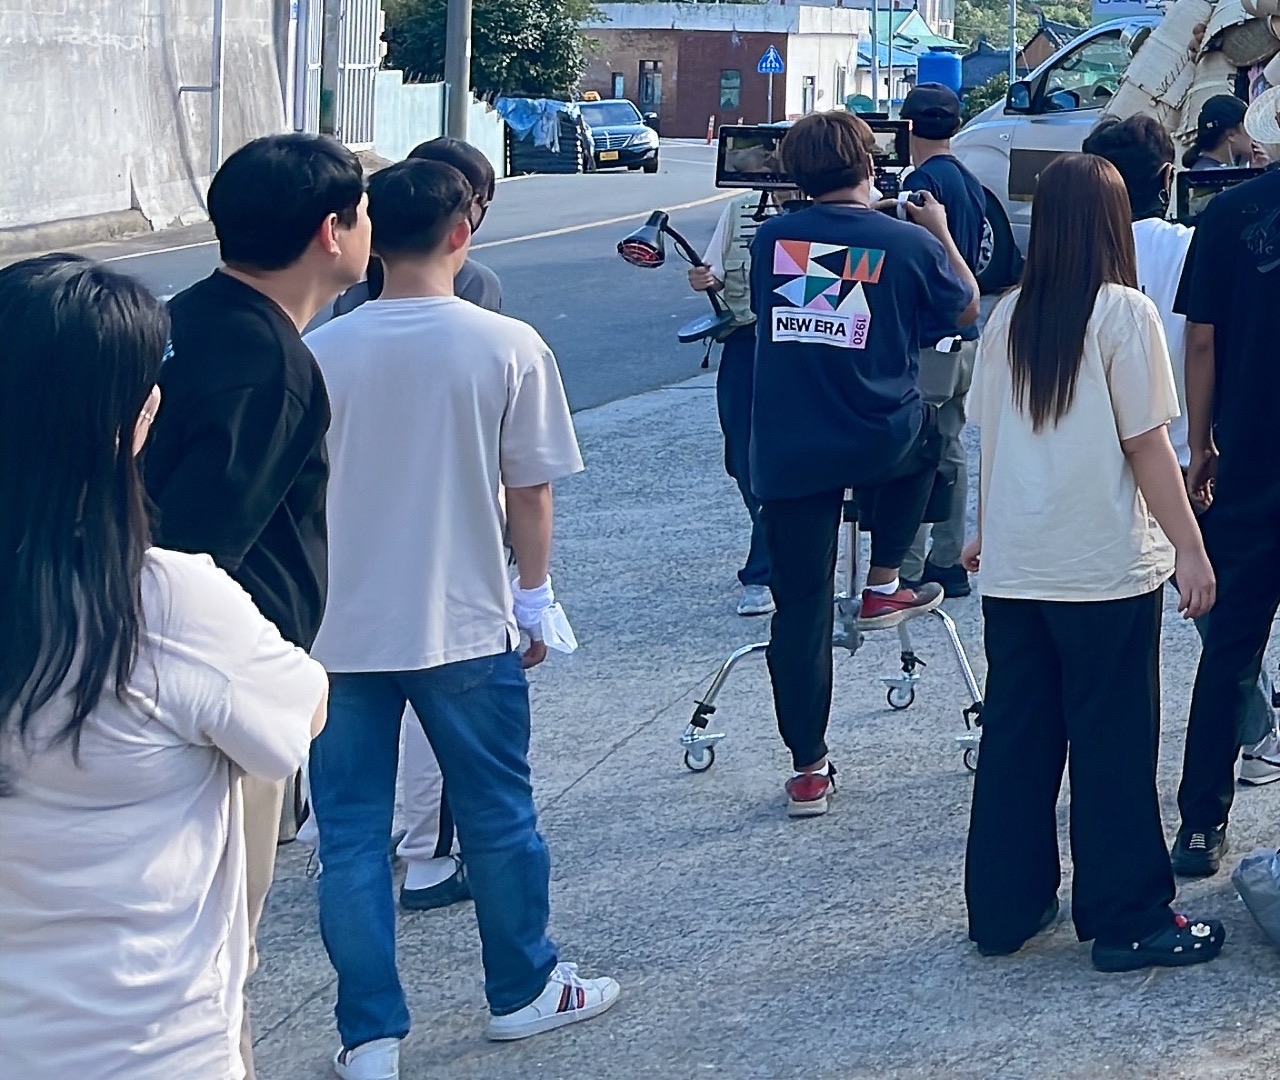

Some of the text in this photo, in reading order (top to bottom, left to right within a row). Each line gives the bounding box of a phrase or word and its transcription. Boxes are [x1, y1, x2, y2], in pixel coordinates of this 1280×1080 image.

[776, 316, 846, 337] NEW ERA
[853, 318, 866, 345] 1920
